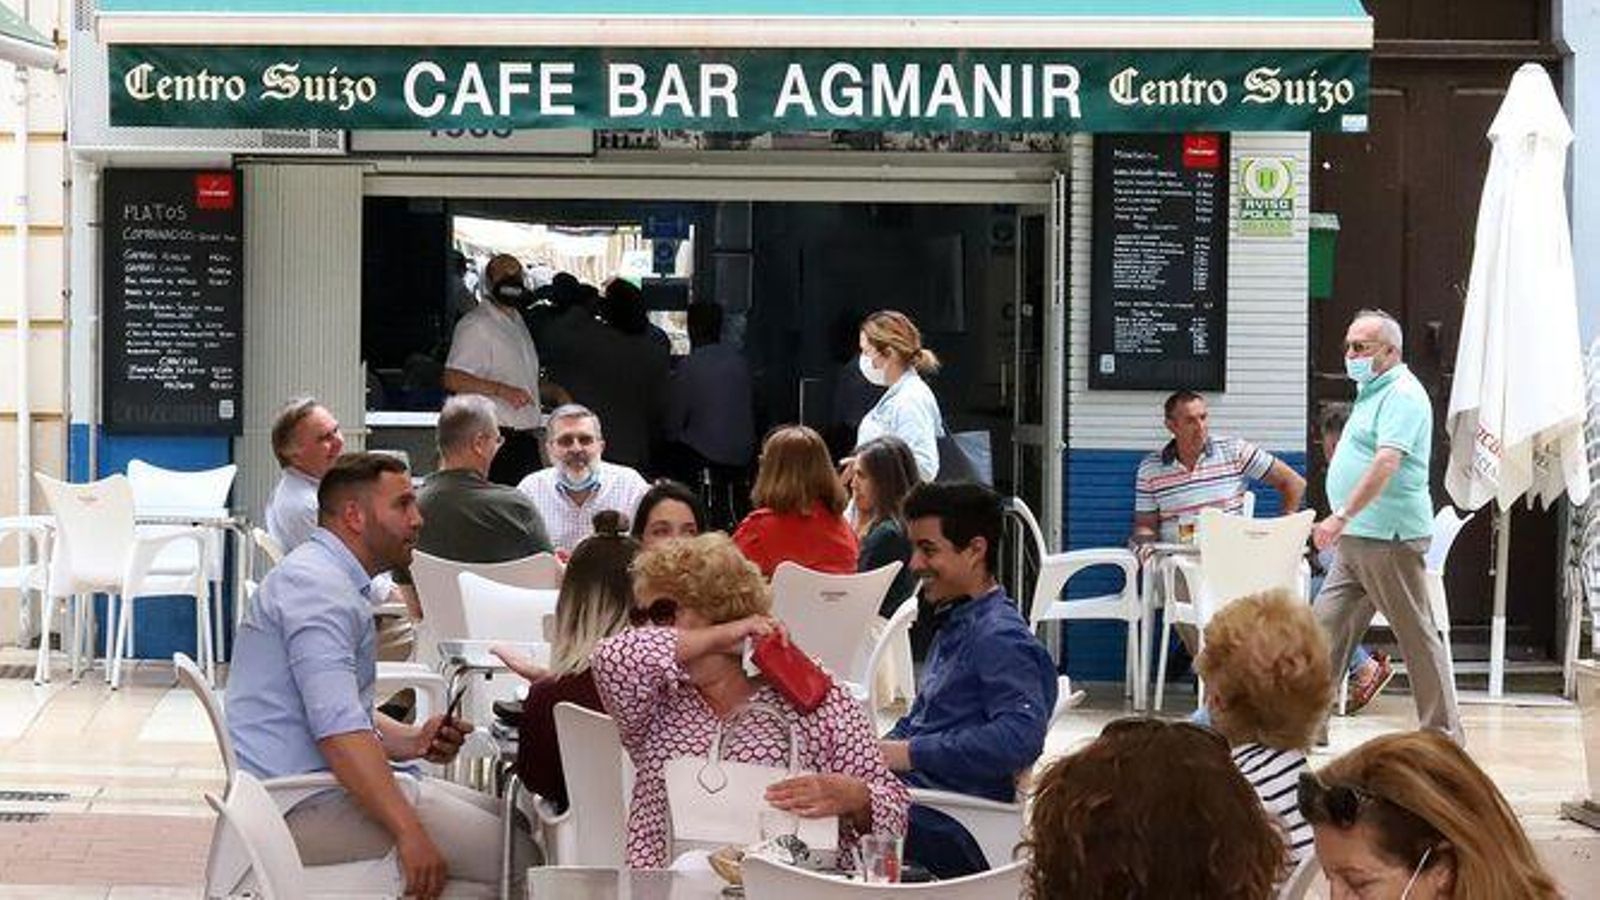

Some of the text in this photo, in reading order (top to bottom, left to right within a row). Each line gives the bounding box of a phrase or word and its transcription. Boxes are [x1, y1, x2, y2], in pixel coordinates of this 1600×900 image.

[124, 62, 246, 101] Centro
[403, 61, 576, 117] CAFE
[608, 63, 739, 118] BAR
[773, 62, 1082, 119] AGMANIR
[1108, 66, 1228, 105] Centro
[124, 204, 187, 221] PLATOS
[1245, 199, 1290, 210] AVISO
